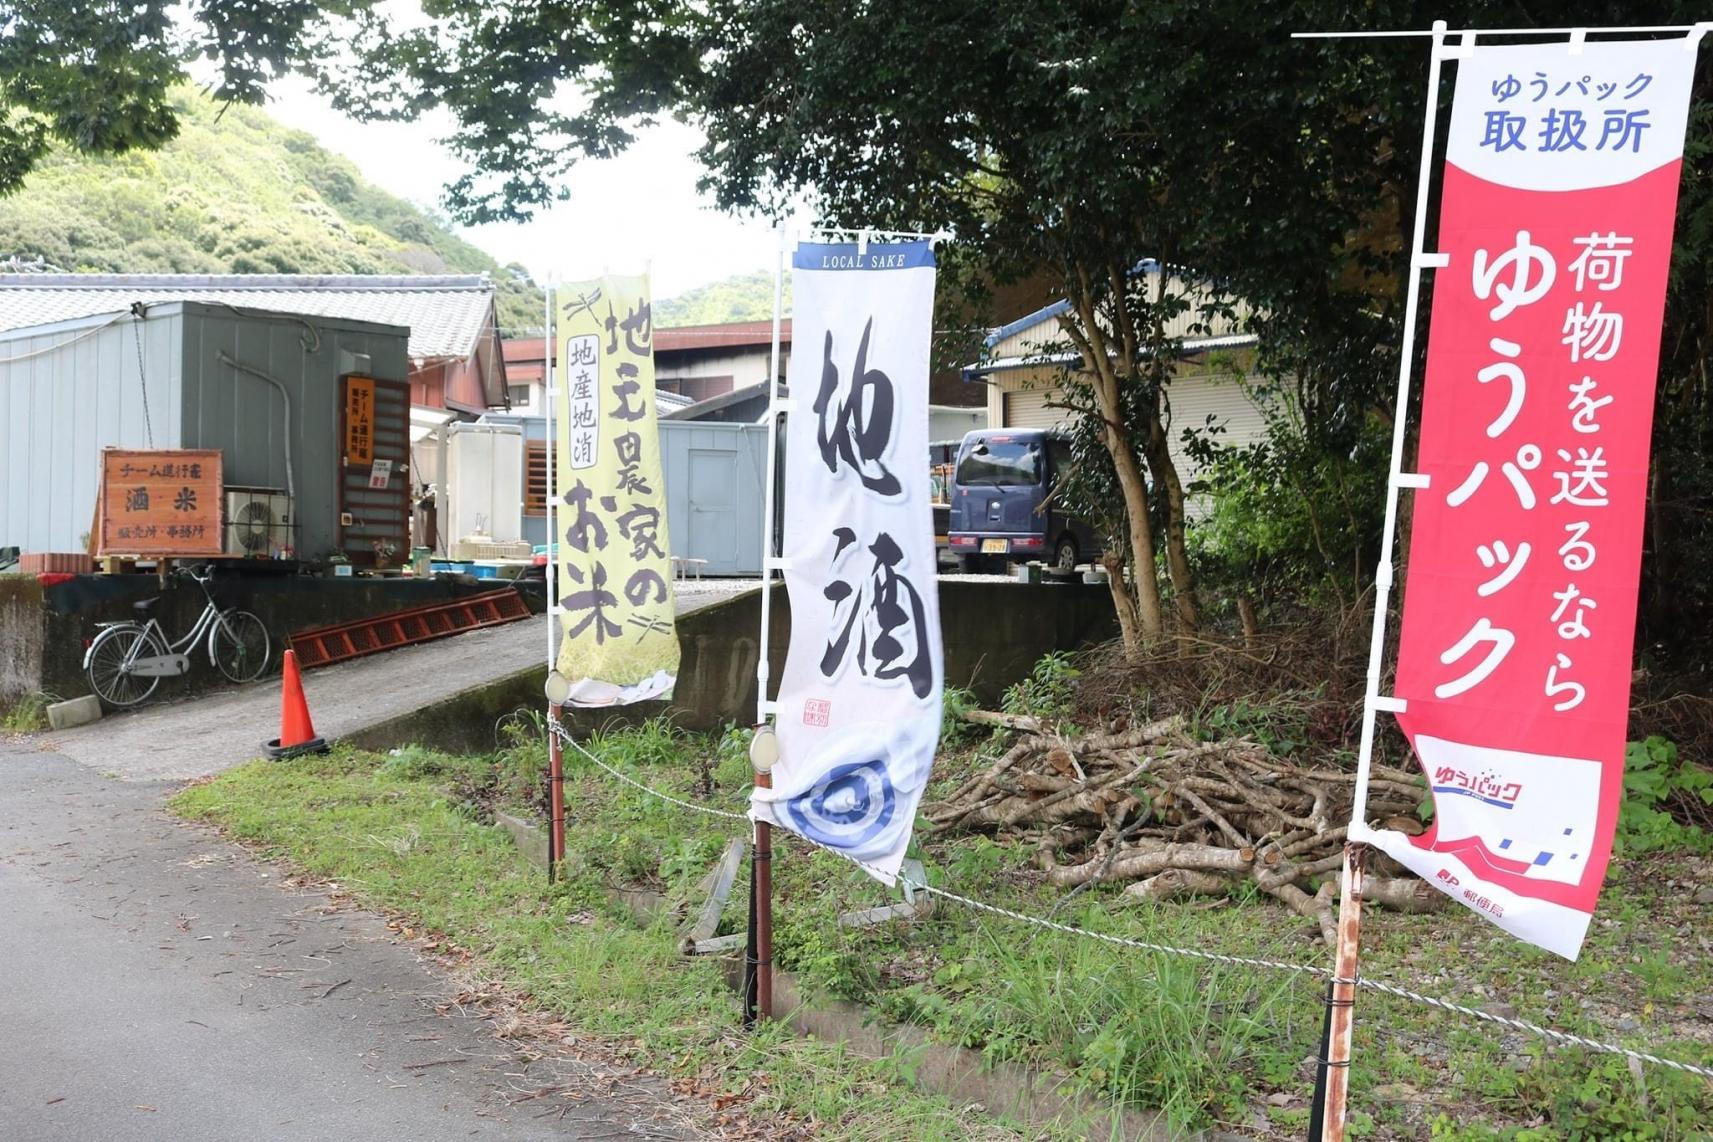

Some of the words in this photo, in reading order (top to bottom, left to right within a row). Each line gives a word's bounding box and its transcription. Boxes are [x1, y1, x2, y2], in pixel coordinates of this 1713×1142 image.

[1479, 107, 1652, 153] 取扱所
[1492, 71, 1653, 102] ゆうパック
[822, 255, 864, 268] LOCAL
[871, 254, 905, 268] SAKE
[570, 338, 597, 464] 地産地消
[604, 296, 668, 607] 地元農家の
[813, 314, 933, 700] 地酒
[1435, 230, 1557, 699] ゆうパック
[1545, 231, 1634, 712] 荷物を送るなら
[559, 477, 624, 646] お米
[1435, 766, 1522, 801] ゆうパック
[1463, 888, 1505, 919] 郵便局
